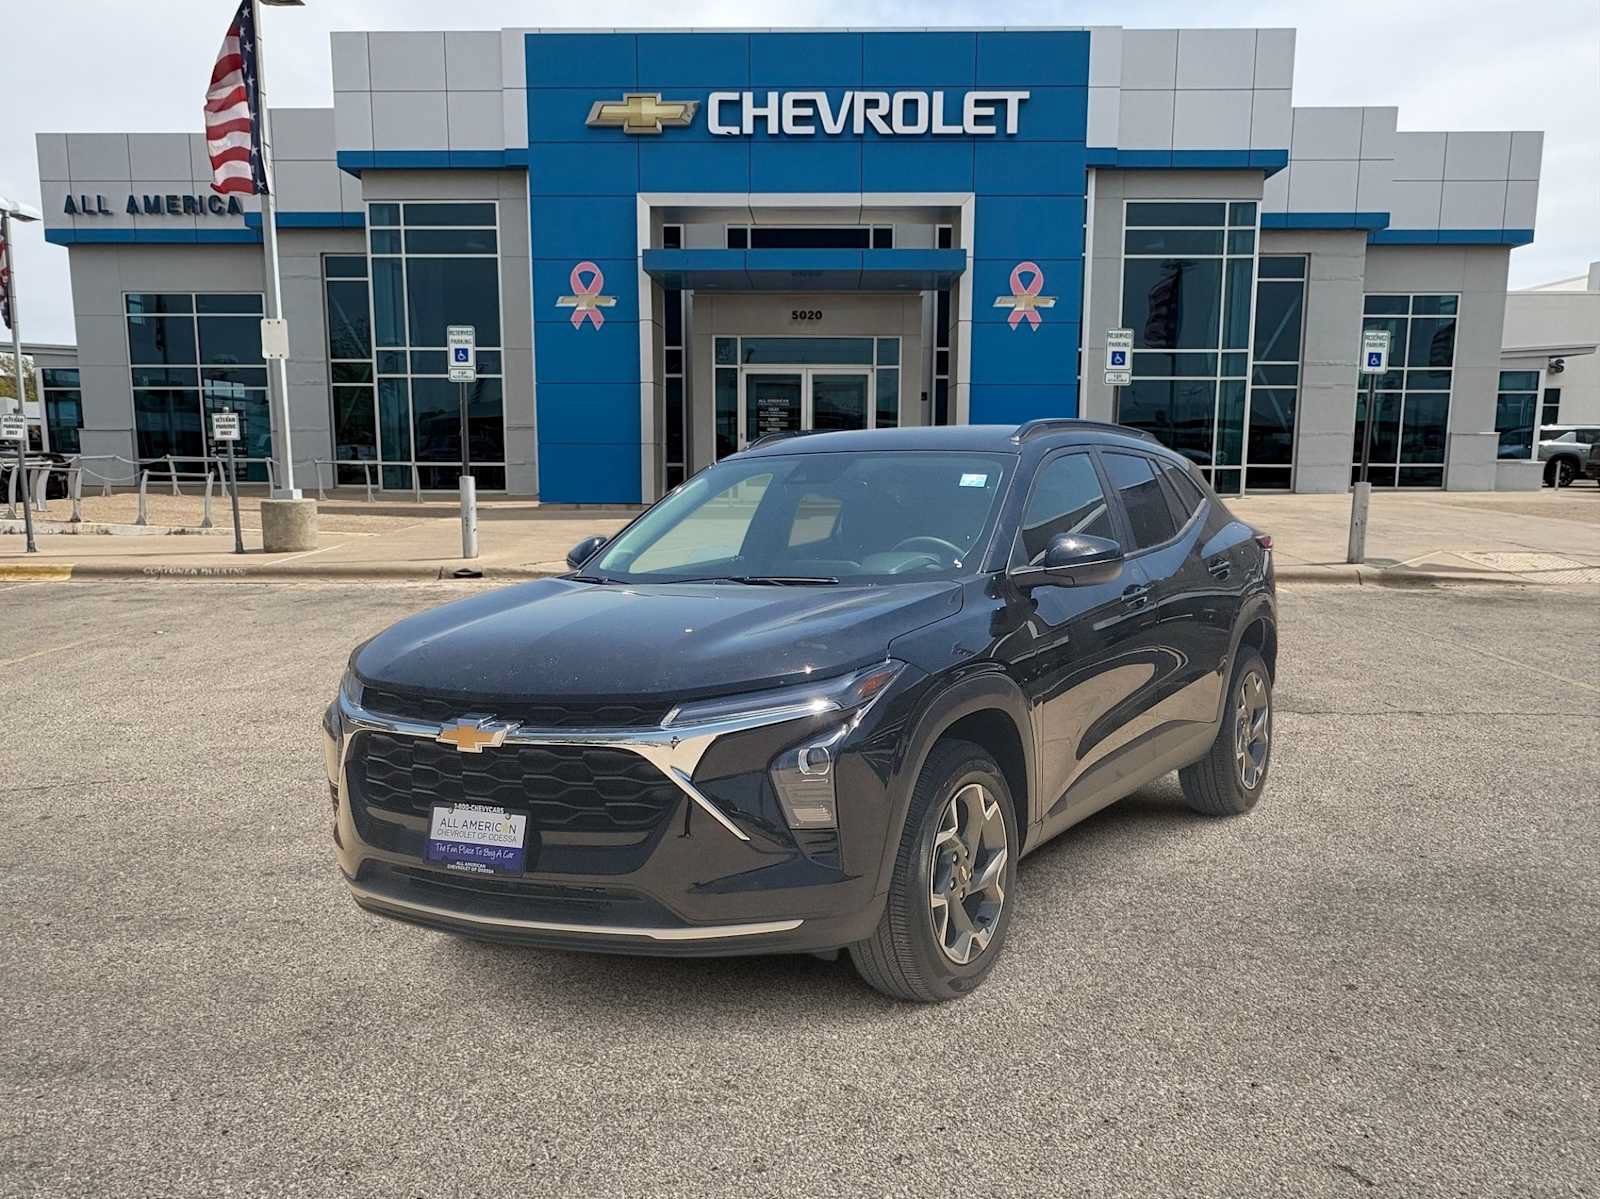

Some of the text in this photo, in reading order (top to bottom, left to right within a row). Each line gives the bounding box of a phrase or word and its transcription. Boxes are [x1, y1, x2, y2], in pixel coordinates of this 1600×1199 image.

[707, 91, 1030, 135] CHEVROLET
[64, 194, 111, 215] ALL
[791, 310, 823, 320] 5020
[440, 818, 458, 829] ALL
[437, 829, 517, 843] CHEVROLET OF ODESSA
[459, 845, 474, 856] Place
[475, 846, 483, 856] To
[483, 847, 496, 860] Buy
[496, 849, 502, 858] A
[503, 850, 514, 859] Car
